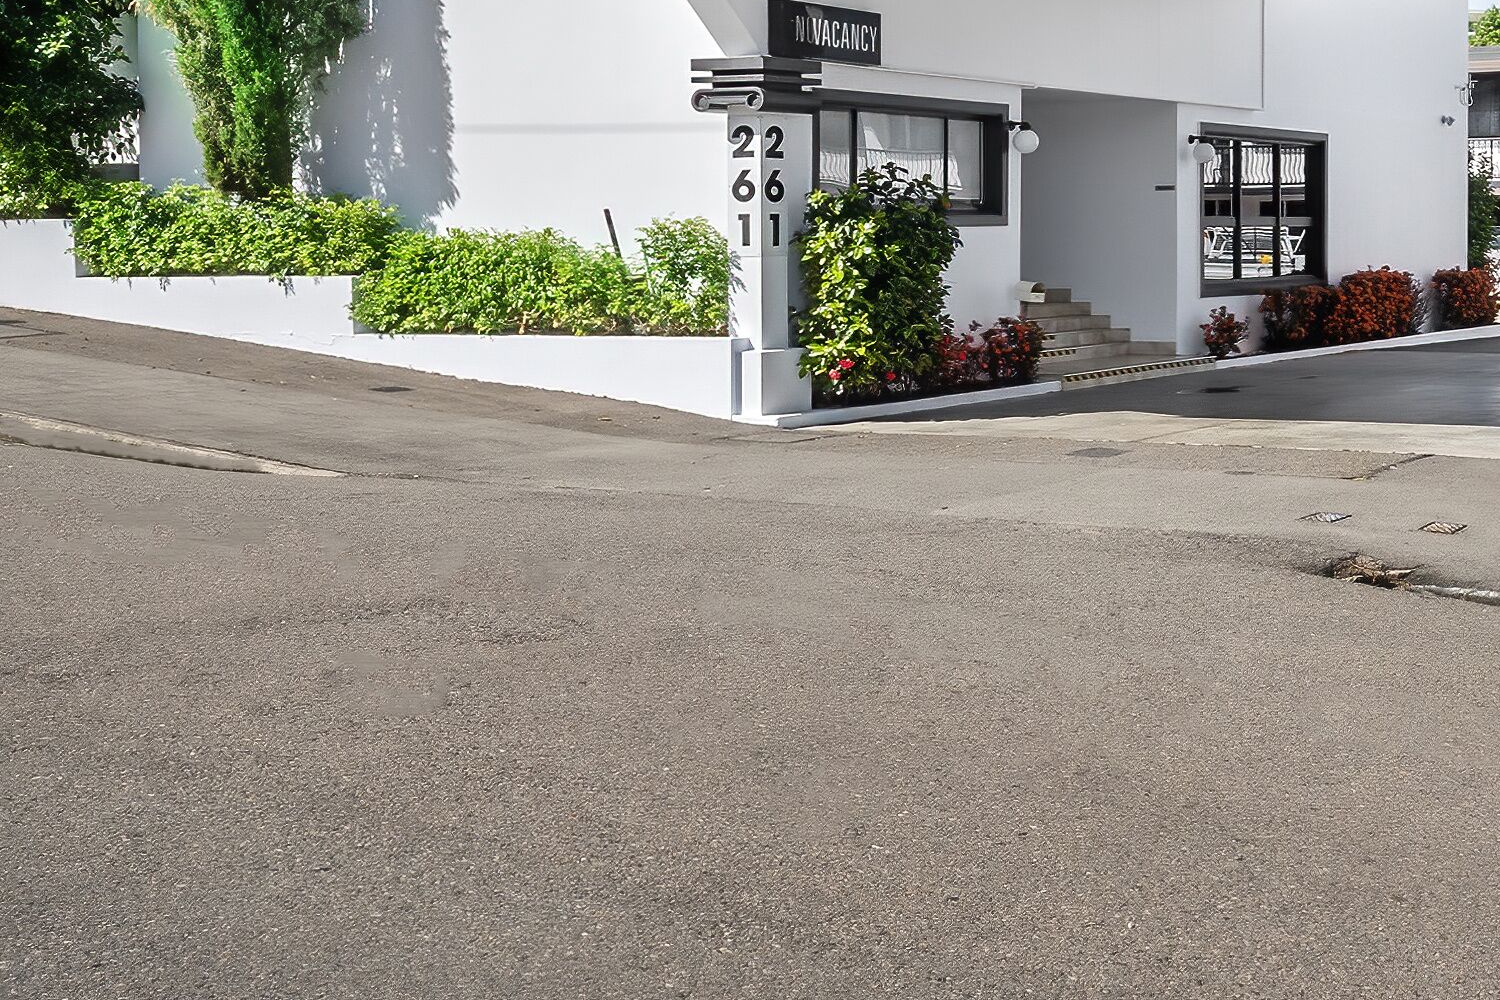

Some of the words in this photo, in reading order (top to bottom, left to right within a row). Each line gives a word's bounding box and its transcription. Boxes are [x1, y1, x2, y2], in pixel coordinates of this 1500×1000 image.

[812, 17, 877, 52] VACANCY
[731, 125, 755, 247] 261
[764, 125, 784, 247] 261
